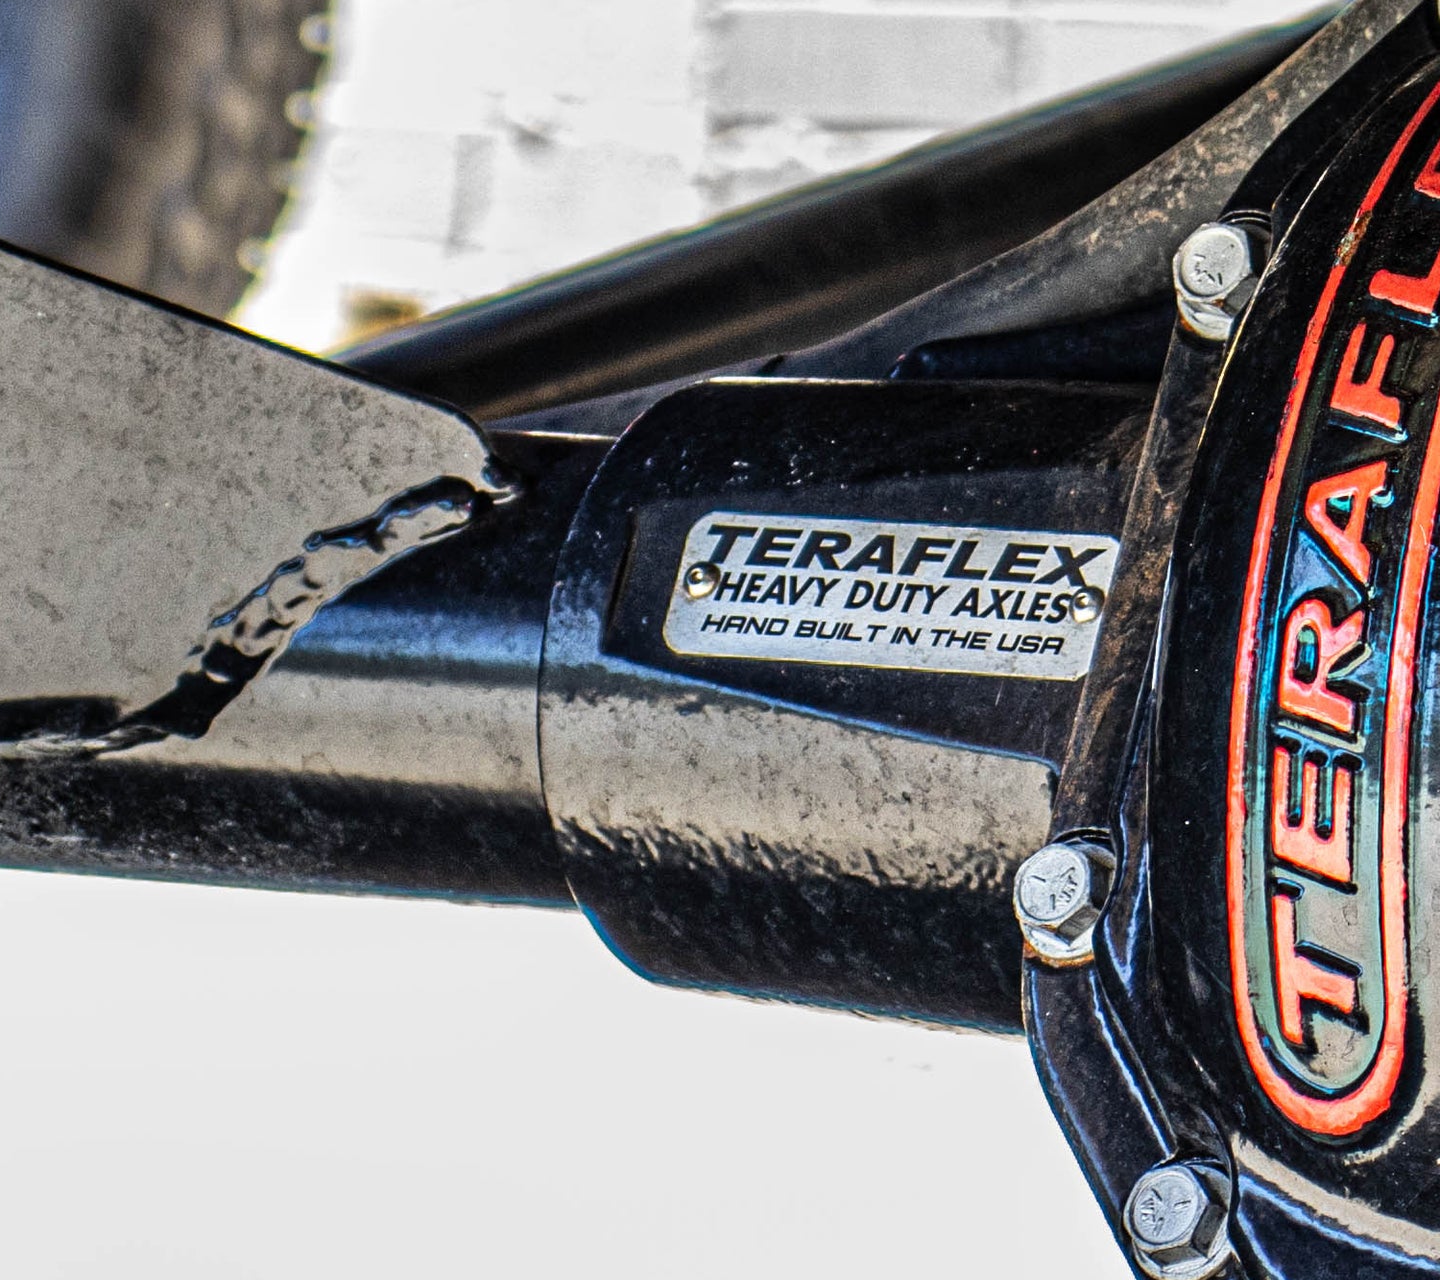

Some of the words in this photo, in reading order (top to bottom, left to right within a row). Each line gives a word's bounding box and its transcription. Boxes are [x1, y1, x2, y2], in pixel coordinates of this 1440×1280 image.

[706, 524, 1106, 586] TERAFLEX
[714, 572, 841, 608] HEAVY
[846, 580, 948, 615] DUTY
[952, 586, 1073, 625] AXLES
[700, 613, 790, 637] HAND
[793, 620, 885, 642] BUILT
[890, 627, 923, 646] IN
[929, 628, 991, 651] THE
[996, 634, 1065, 656] USA
